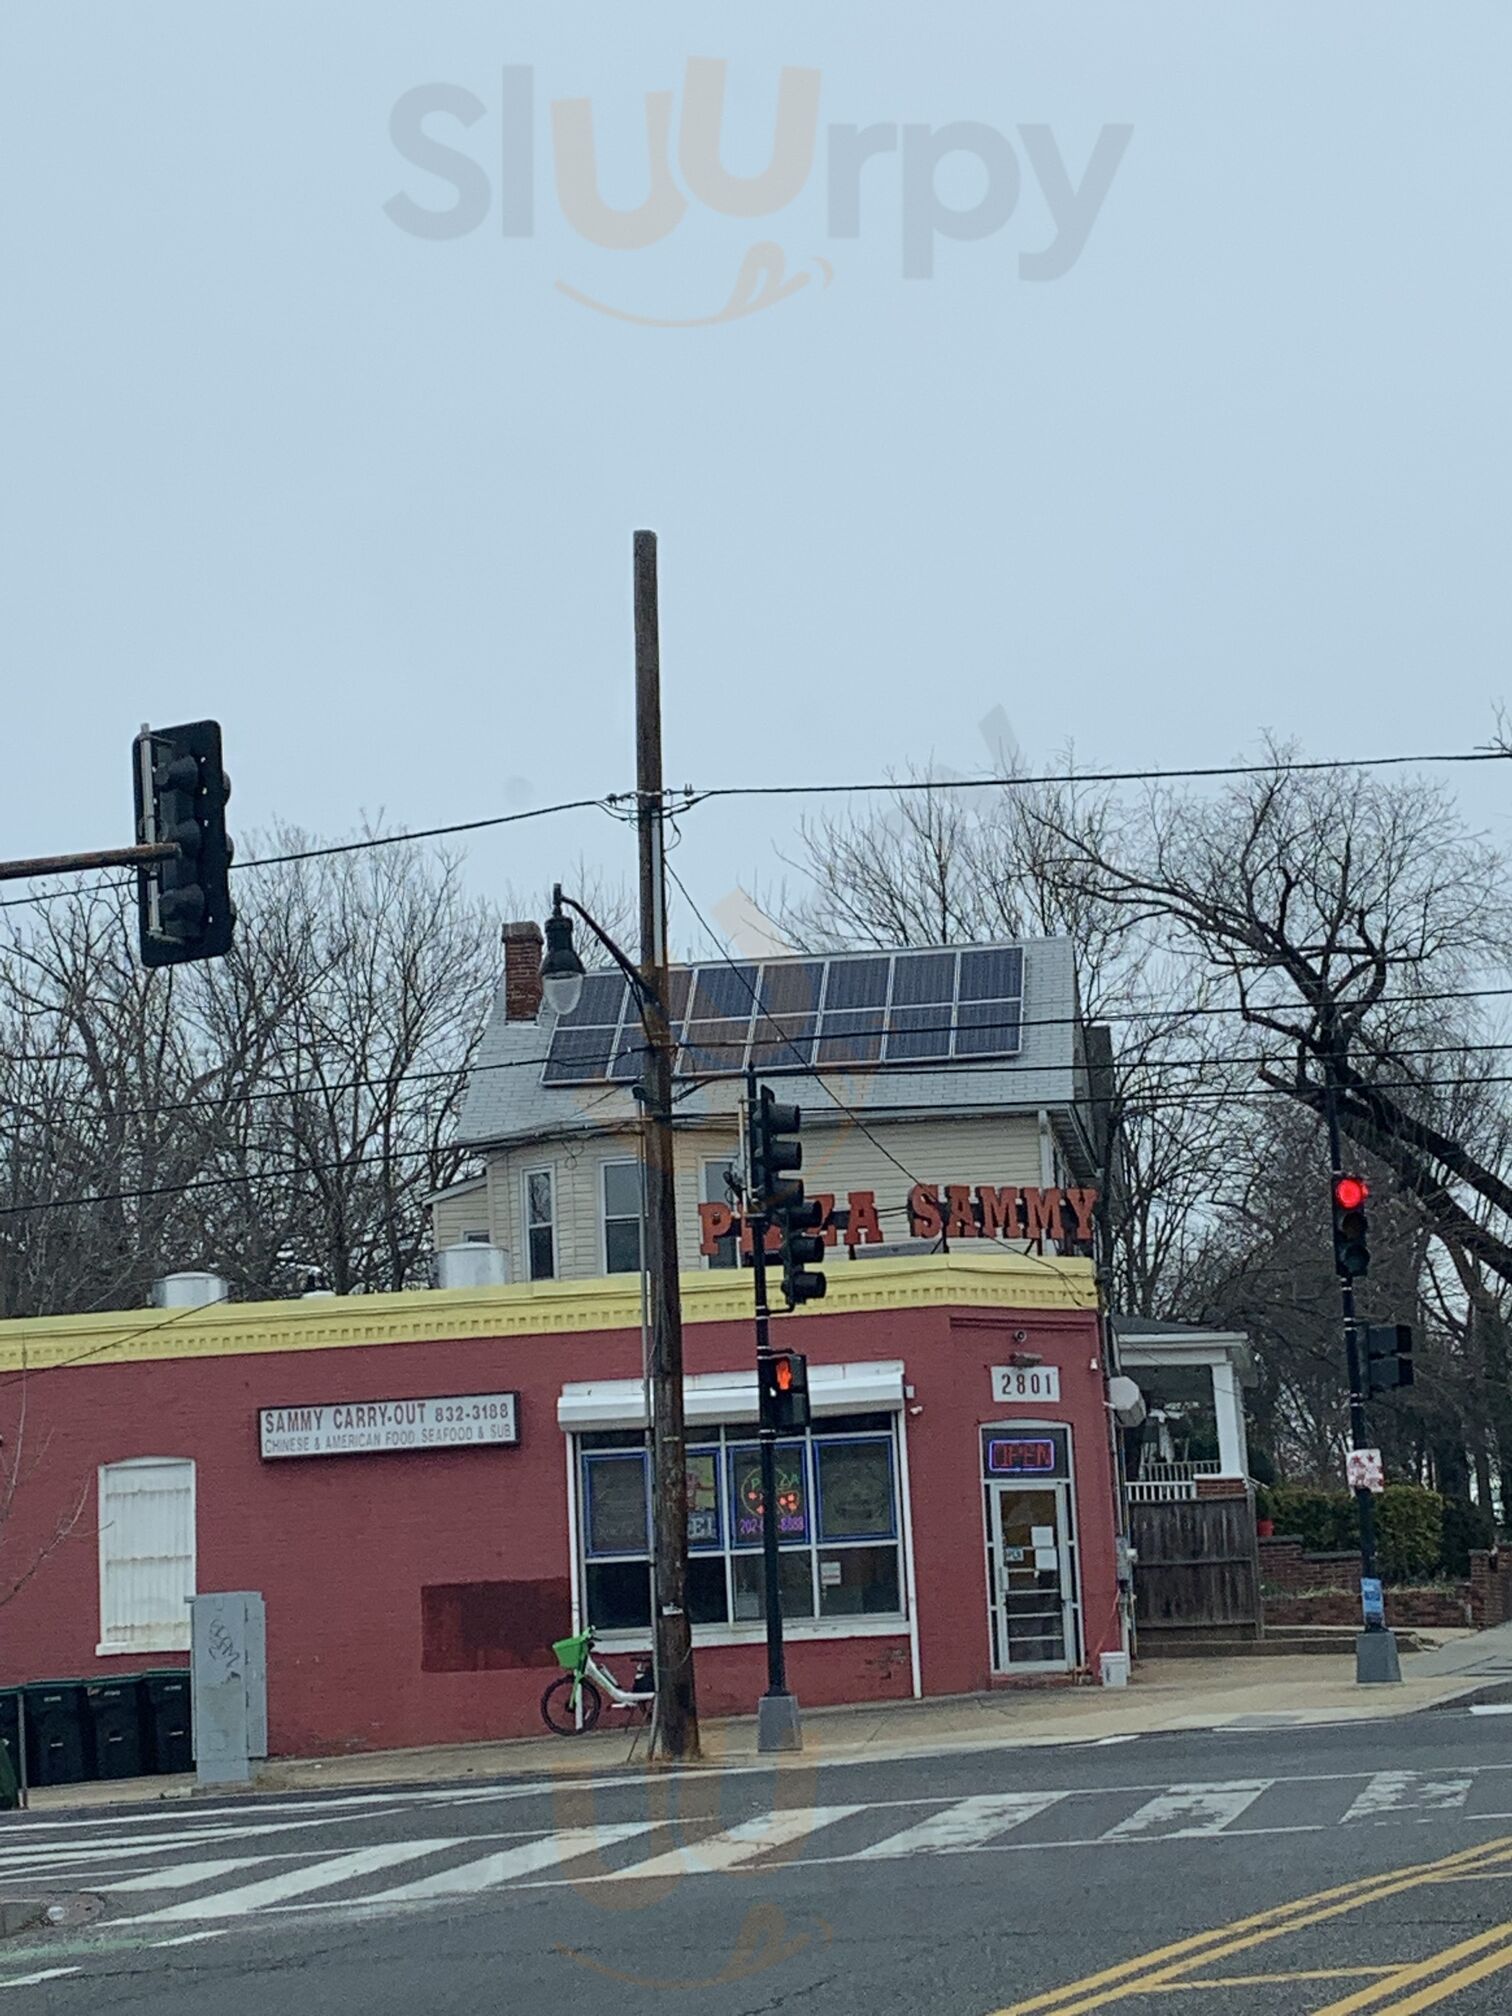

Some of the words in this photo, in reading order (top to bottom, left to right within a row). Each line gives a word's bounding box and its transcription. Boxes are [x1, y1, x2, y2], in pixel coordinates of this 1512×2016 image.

[698, 1190, 885, 1256] PZA
[908, 1183, 1099, 1240] SAMMY
[1001, 1373, 1052, 1395] 2801
[264, 1408, 323, 1434] SAMMY
[435, 1402, 508, 1423] 832-3188
[264, 1436, 309, 1454] CHINESE
[314, 1436, 321, 1451] &
[325, 1432, 381, 1450] AMERICAN
[385, 1430, 415, 1446] FOOD
[421, 1425, 473, 1443] SEAFOOD
[478, 1426, 484, 1440] &
[490, 1423, 511, 1439] SUB
[993, 1444, 1052, 1467] OPEN
[751, 1473, 800, 1489] PZA
